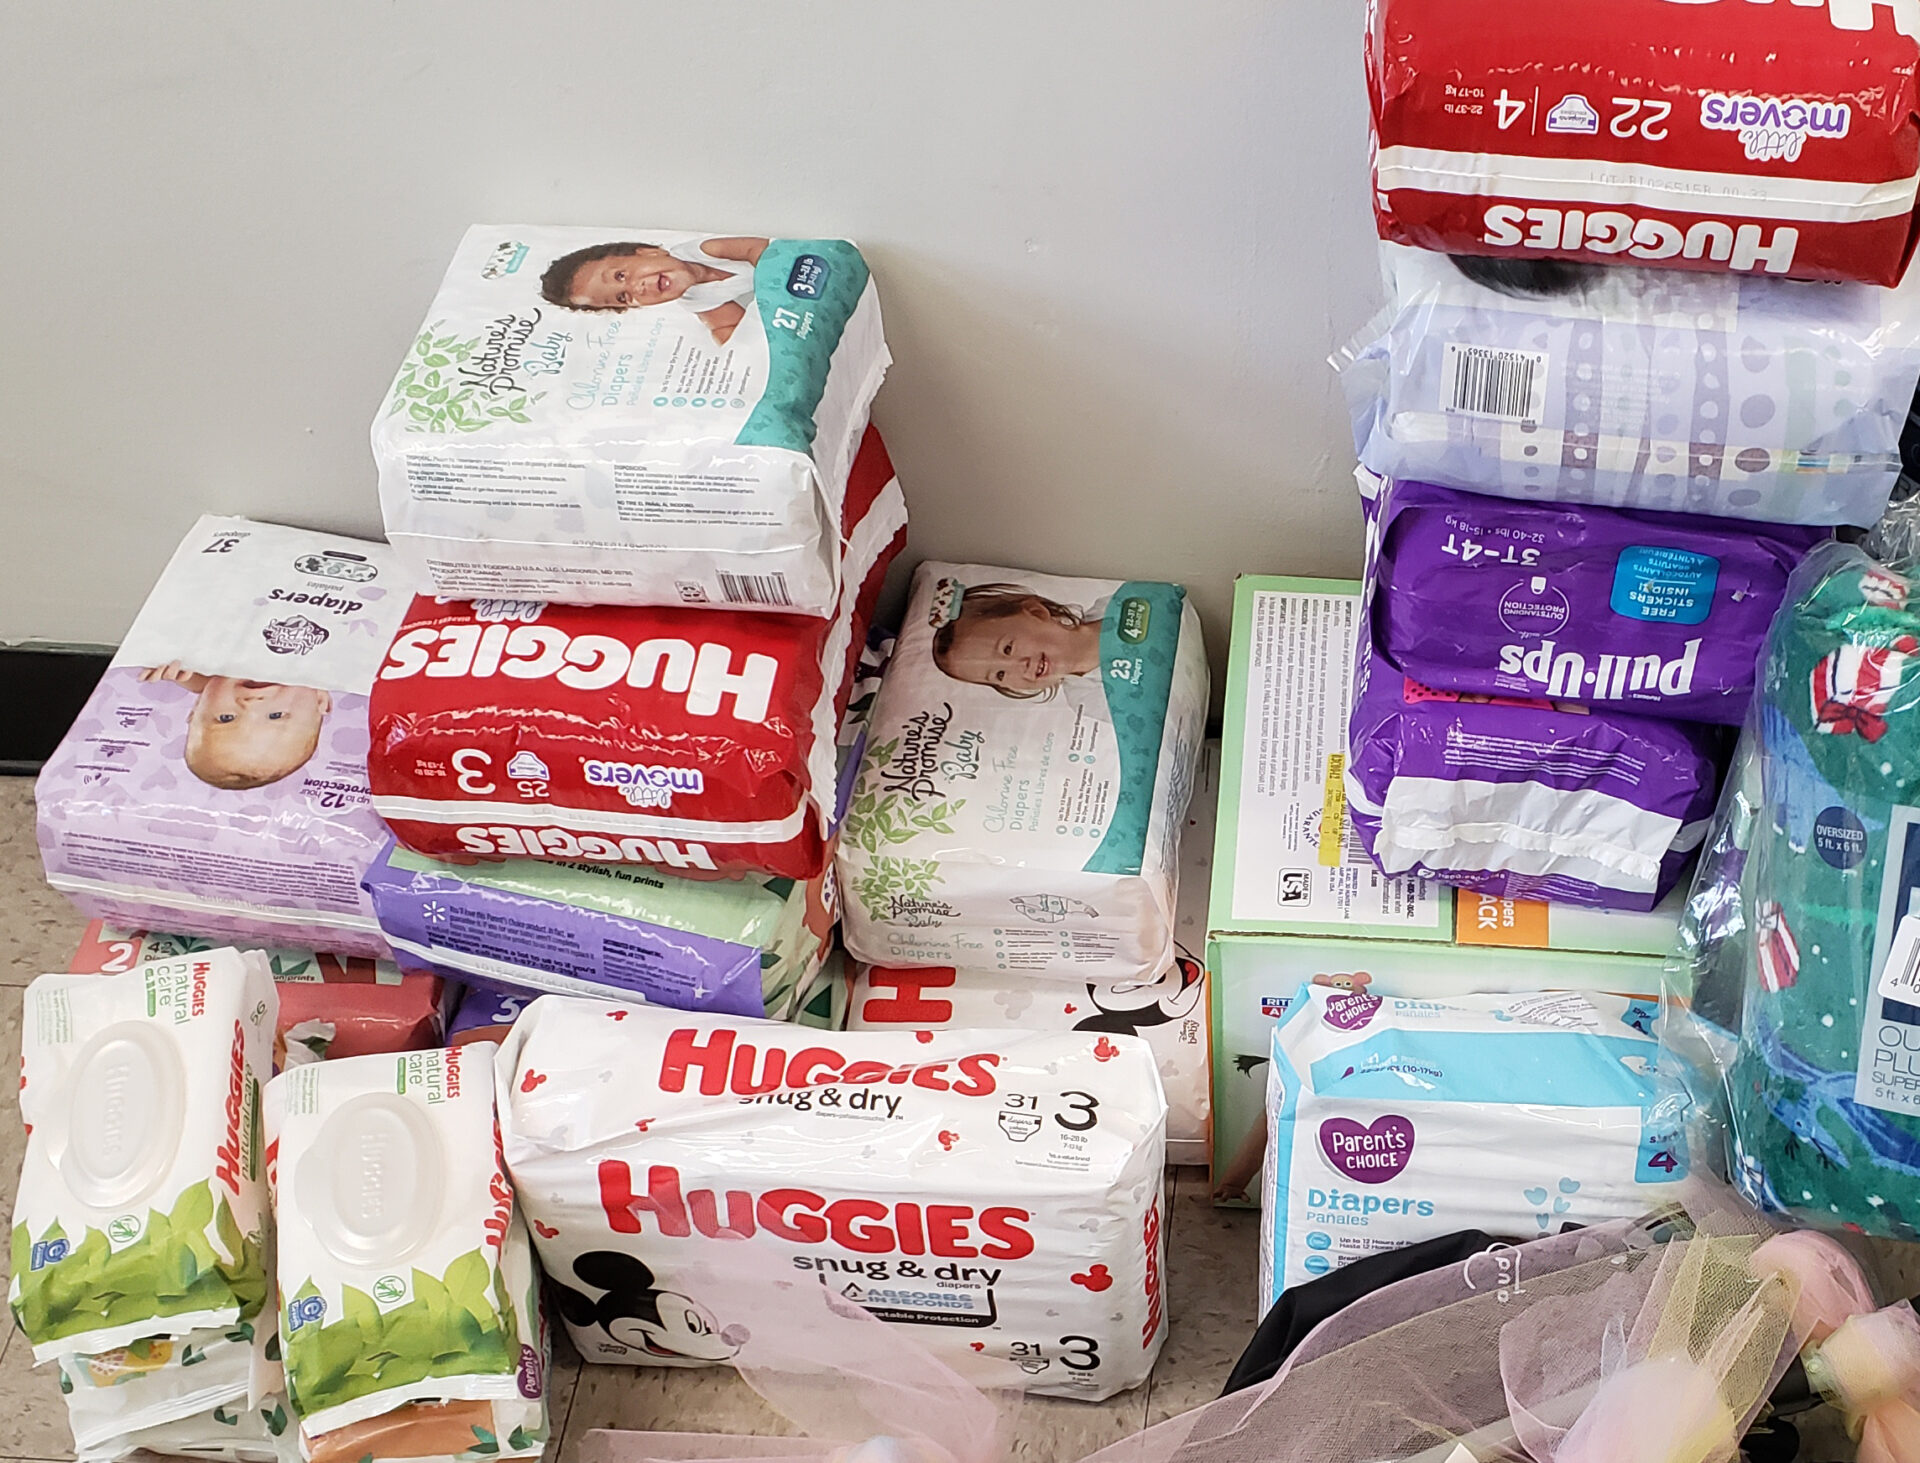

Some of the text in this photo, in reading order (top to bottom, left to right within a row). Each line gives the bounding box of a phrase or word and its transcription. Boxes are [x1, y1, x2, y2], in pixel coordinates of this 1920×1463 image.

[1445, 84, 1485, 98] 10-17 kg
[1454, 104, 1483, 115] 22-37
[1493, 88, 1526, 130] 4
[1609, 97, 1672, 141] 22
[1705, 98, 1845, 132] movers
[1743, 128, 1802, 157] little
[1483, 204, 1799, 273] HUGGIES
[792, 282, 815, 295] 3
[772, 307, 800, 330] 27
[796, 311, 815, 340] Diapers
[457, 314, 516, 388] Nature's
[489, 308, 542, 396] Promise
[523, 331, 573, 377] Baby
[601, 353, 633, 407] Diapers
[1444, 514, 1546, 544] 32-40 lbs 15-18 kg
[201, 538, 240, 554] 37
[1441, 533, 1541, 567] 3T-4T
[268, 588, 364, 615] diapers
[1503, 600, 1566, 614] PROTECTION
[1628, 591, 1695, 607] STICKERS
[1641, 606, 1677, 618] FREE
[1503, 608, 1565, 621] OUTSTANDING
[1123, 628, 1143, 639] 4
[379, 624, 779, 724] HUGGIES
[1110, 659, 1132, 680] 23
[1129, 658, 1143, 685] Diapers
[881, 711, 930, 793] Nature's
[911, 701, 953, 801] Promise
[940, 730, 985, 781] Baby
[451, 747, 496, 795] 3
[588, 761, 700, 793] movers
[298, 787, 322, 799] hour
[303, 778, 373, 796] protection
[320, 791, 346, 809] 12
[356, 795, 371, 805] up
[516, 780, 550, 798] 25
[624, 786, 672, 808] little
[983, 744, 1018, 833] Chlorine Free
[1009, 779, 1031, 831] Diapers
[1816, 824, 1863, 841] OVERSIZED
[1817, 837, 1823, 847] 5
[1824, 839, 1834, 849] ft.
[1843, 841, 1850, 852] 6
[1851, 842, 1862, 853] ft.
[456, 825, 719, 871] HUGGIES
[567, 860, 575, 869] 2
[577, 861, 613, 878] stylish,
[614, 869, 632, 882] fun
[633, 876, 665, 889] prints
[1282, 872, 1303, 902] USA
[890, 894, 953, 910] Nature's
[1303, 892, 1309, 900] IN
[891, 904, 961, 919] Promise
[1477, 892, 1498, 930] ACK
[1502, 897, 1516, 928] pers
[147, 941, 174, 955] 42
[890, 946, 952, 961] Diapers
[952, 932, 984, 950] Free
[100, 942, 133, 972] 2
[156, 964, 172, 1007] care
[191, 961, 211, 1017] HUGGIES
[287, 974, 316, 983] prints
[1890, 978, 1899, 987] 4
[173, 962, 191, 1026] natural
[491, 993, 520, 1023] 3
[1327, 993, 1380, 1018] Parents
[249, 999, 268, 1026] 56
[1339, 1001, 1375, 1024] CHOICE
[1188, 1019, 1200, 1044] baby
[408, 1053, 423, 1085] care
[445, 1045, 463, 1099] HUGGIES
[657, 1027, 1001, 1097] HUGGIES
[426, 1050, 446, 1105] natural
[216, 1019, 245, 1197] HUGGIES
[818, 1087, 842, 1106] &
[848, 1087, 902, 1119] dry
[1874, 1087, 1884, 1098] 5
[1901, 1094, 1909, 1103] x
[1004, 1090, 1100, 1131] 31 3
[241, 1106, 252, 1181] natural
[1332, 1125, 1407, 1153] Parent's
[1346, 1152, 1399, 1169] CHOICE
[1648, 1150, 1678, 1173] 4
[598, 1159, 1035, 1259] HUGGIES
[1307, 1188, 1435, 1217] Diapers
[1306, 1211, 1369, 1227] Pañales
[1339, 1237, 1351, 1246] Up
[792, 1255, 1001, 1288] snug & dry
[936, 1280, 982, 1291] diapers
[867, 1288, 973, 1302] ABSORBS
[868, 1296, 974, 1310] IN SECONDS
[916, 1313, 980, 1324] Protection
[1010, 1335, 1101, 1371] 31 3
